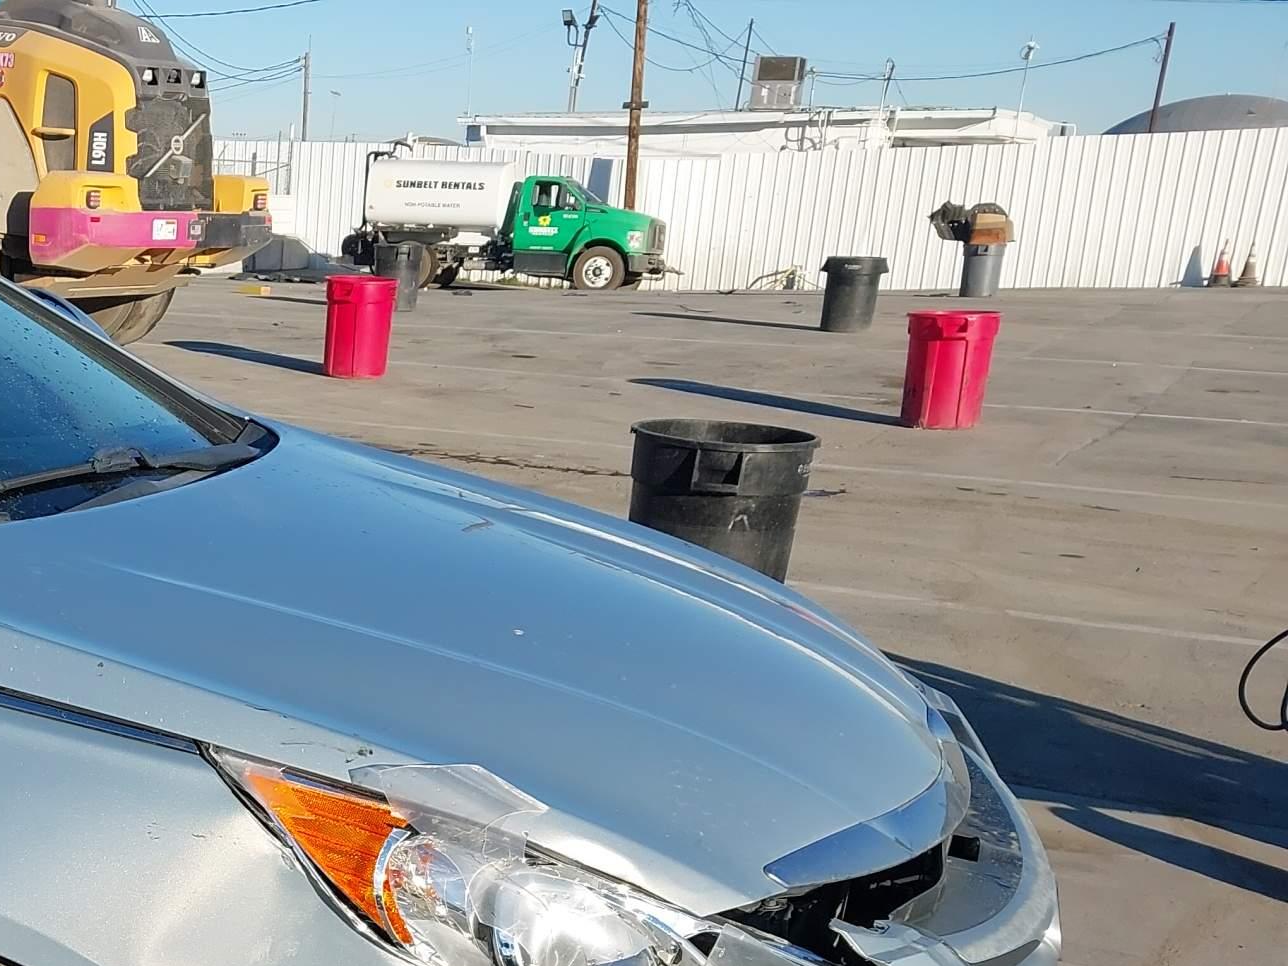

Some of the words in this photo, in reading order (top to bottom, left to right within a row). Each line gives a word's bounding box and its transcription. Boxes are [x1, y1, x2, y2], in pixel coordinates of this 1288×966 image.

[91, 132, 108, 165] L90H
[395, 180, 439, 190] SUNBELT
[440, 181, 485, 191] RENTALS
